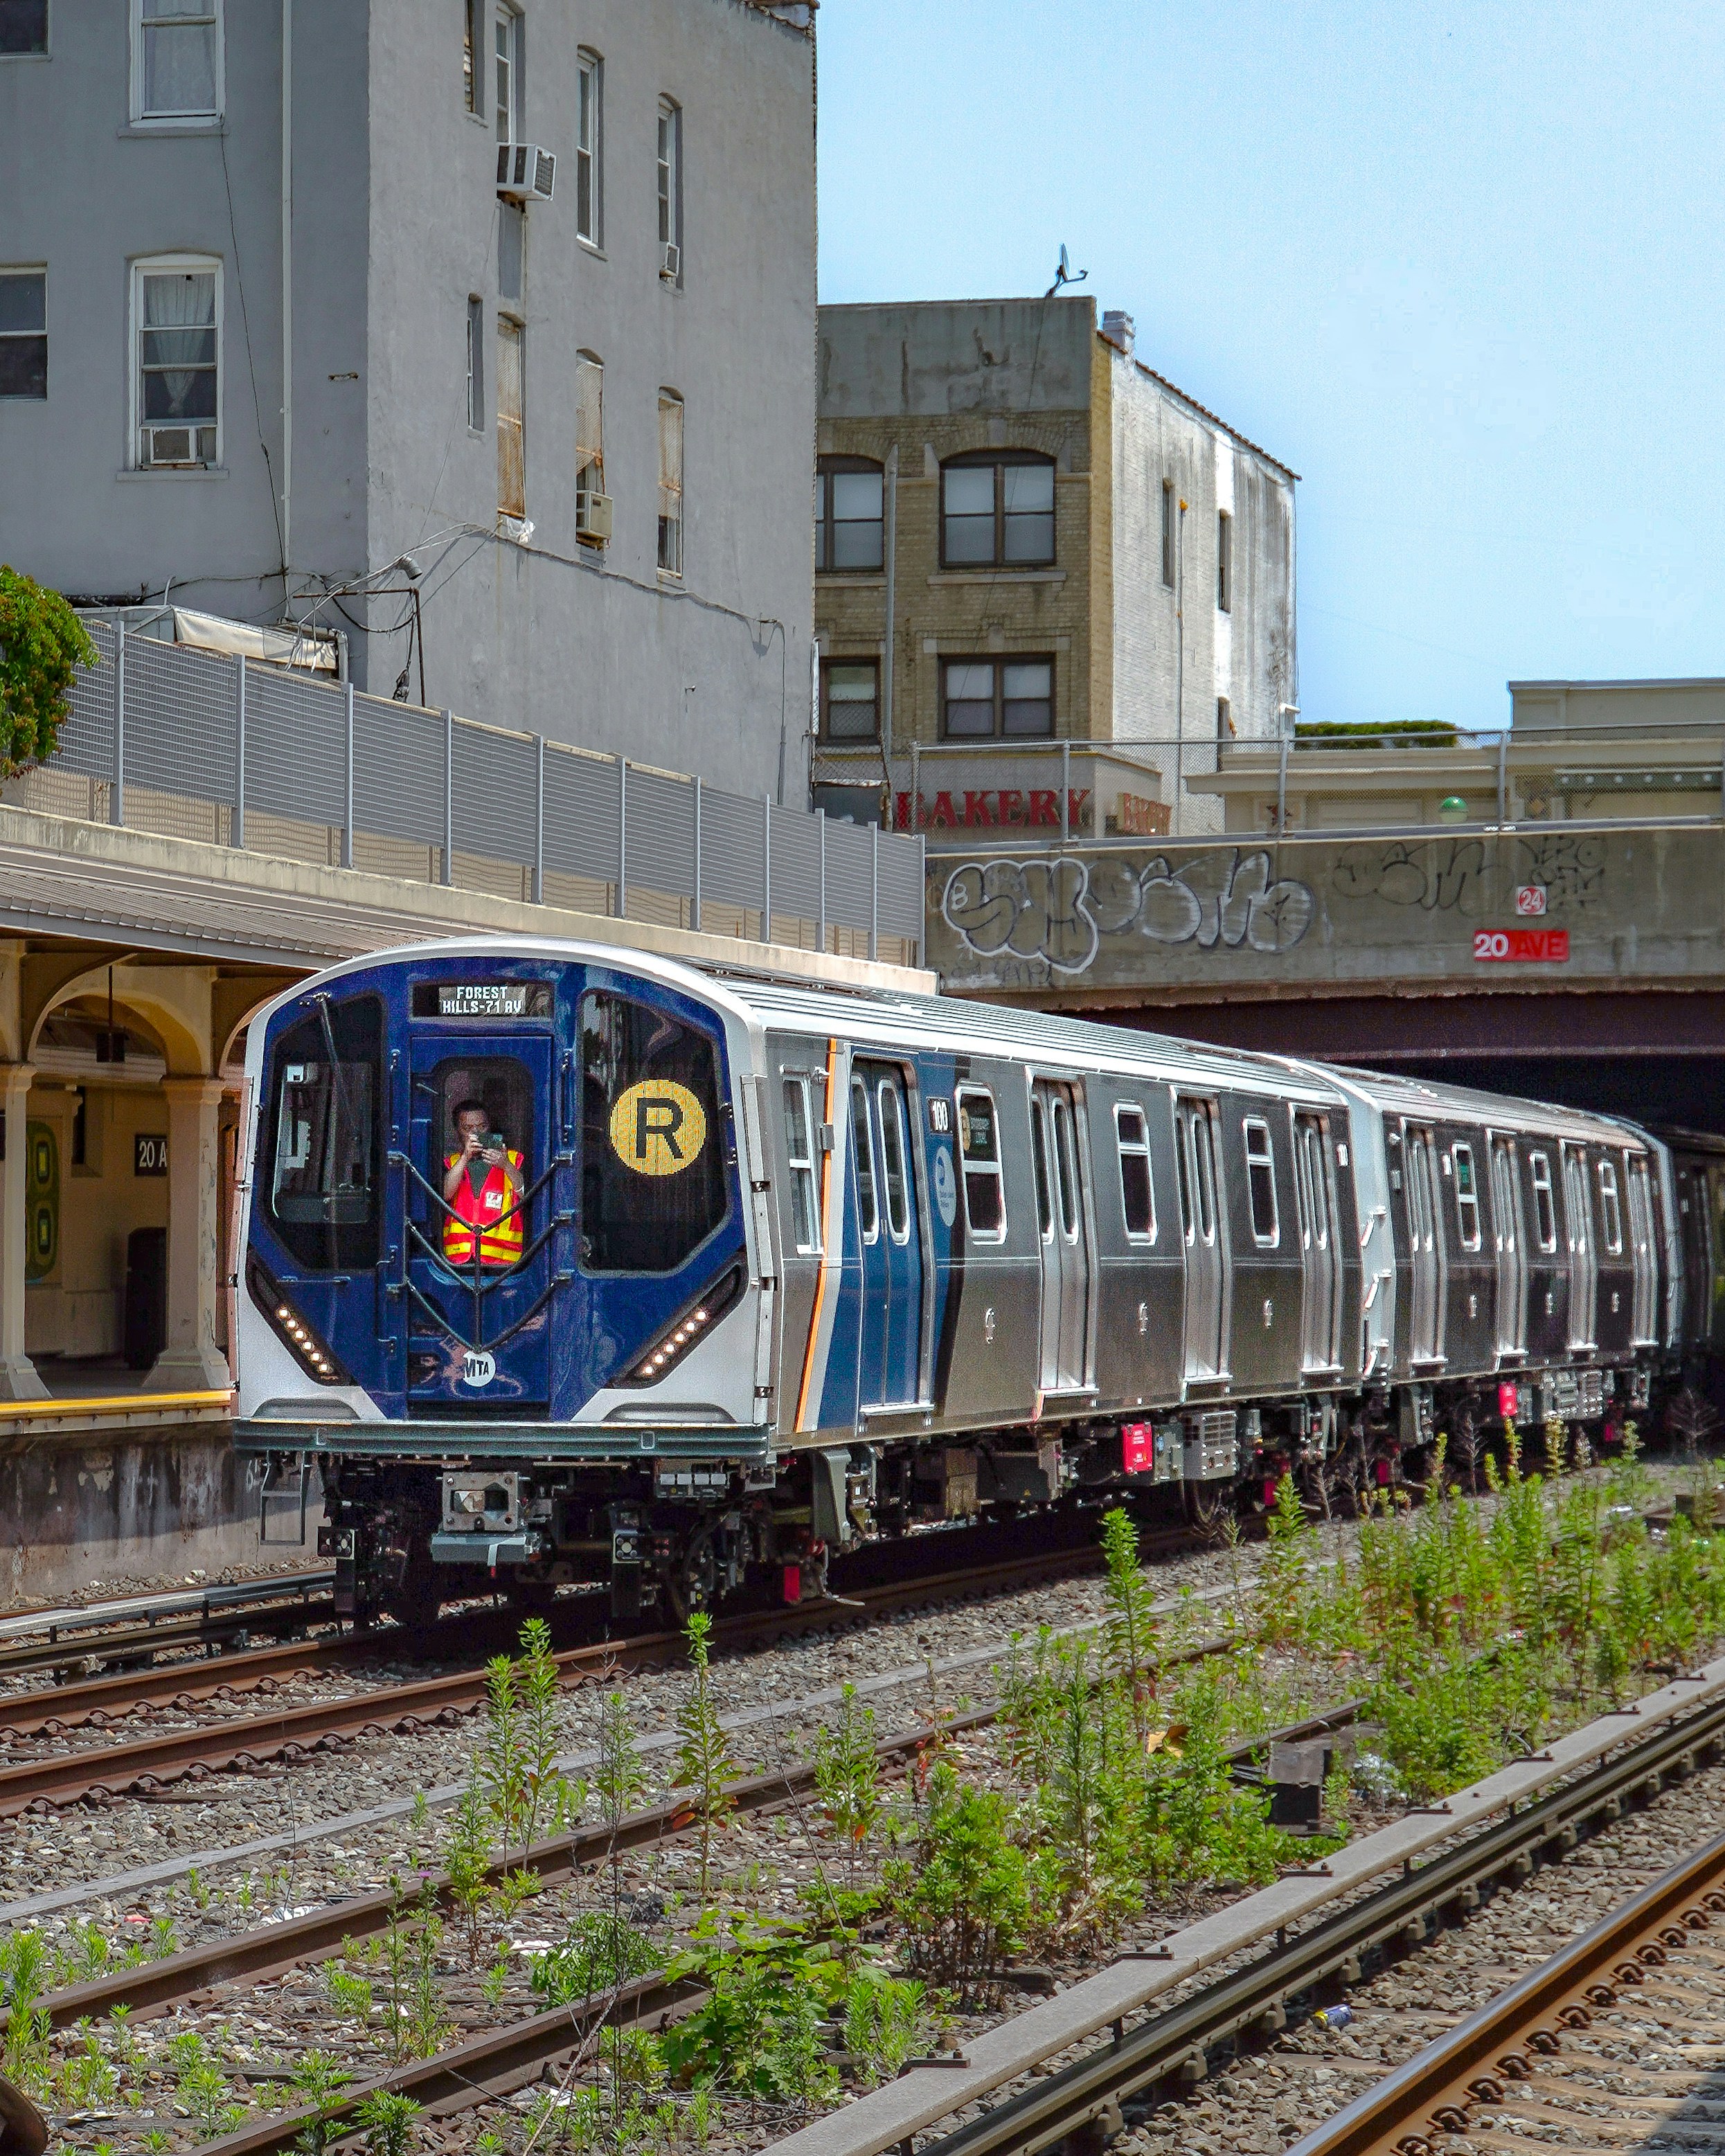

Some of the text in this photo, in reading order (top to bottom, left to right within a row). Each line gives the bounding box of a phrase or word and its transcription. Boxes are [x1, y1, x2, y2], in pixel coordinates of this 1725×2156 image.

[895, 789, 1090, 828] BAKERY
[1521, 890, 1542, 910] 24
[1474, 932, 1564, 958] 20 AVE
[456, 986, 508, 1000] FOREST
[442, 1000, 522, 1014] HILLS-71 AV
[636, 1097, 684, 1159] R
[139, 1141, 154, 1167] 20
[463, 1358, 489, 1378] MTA
